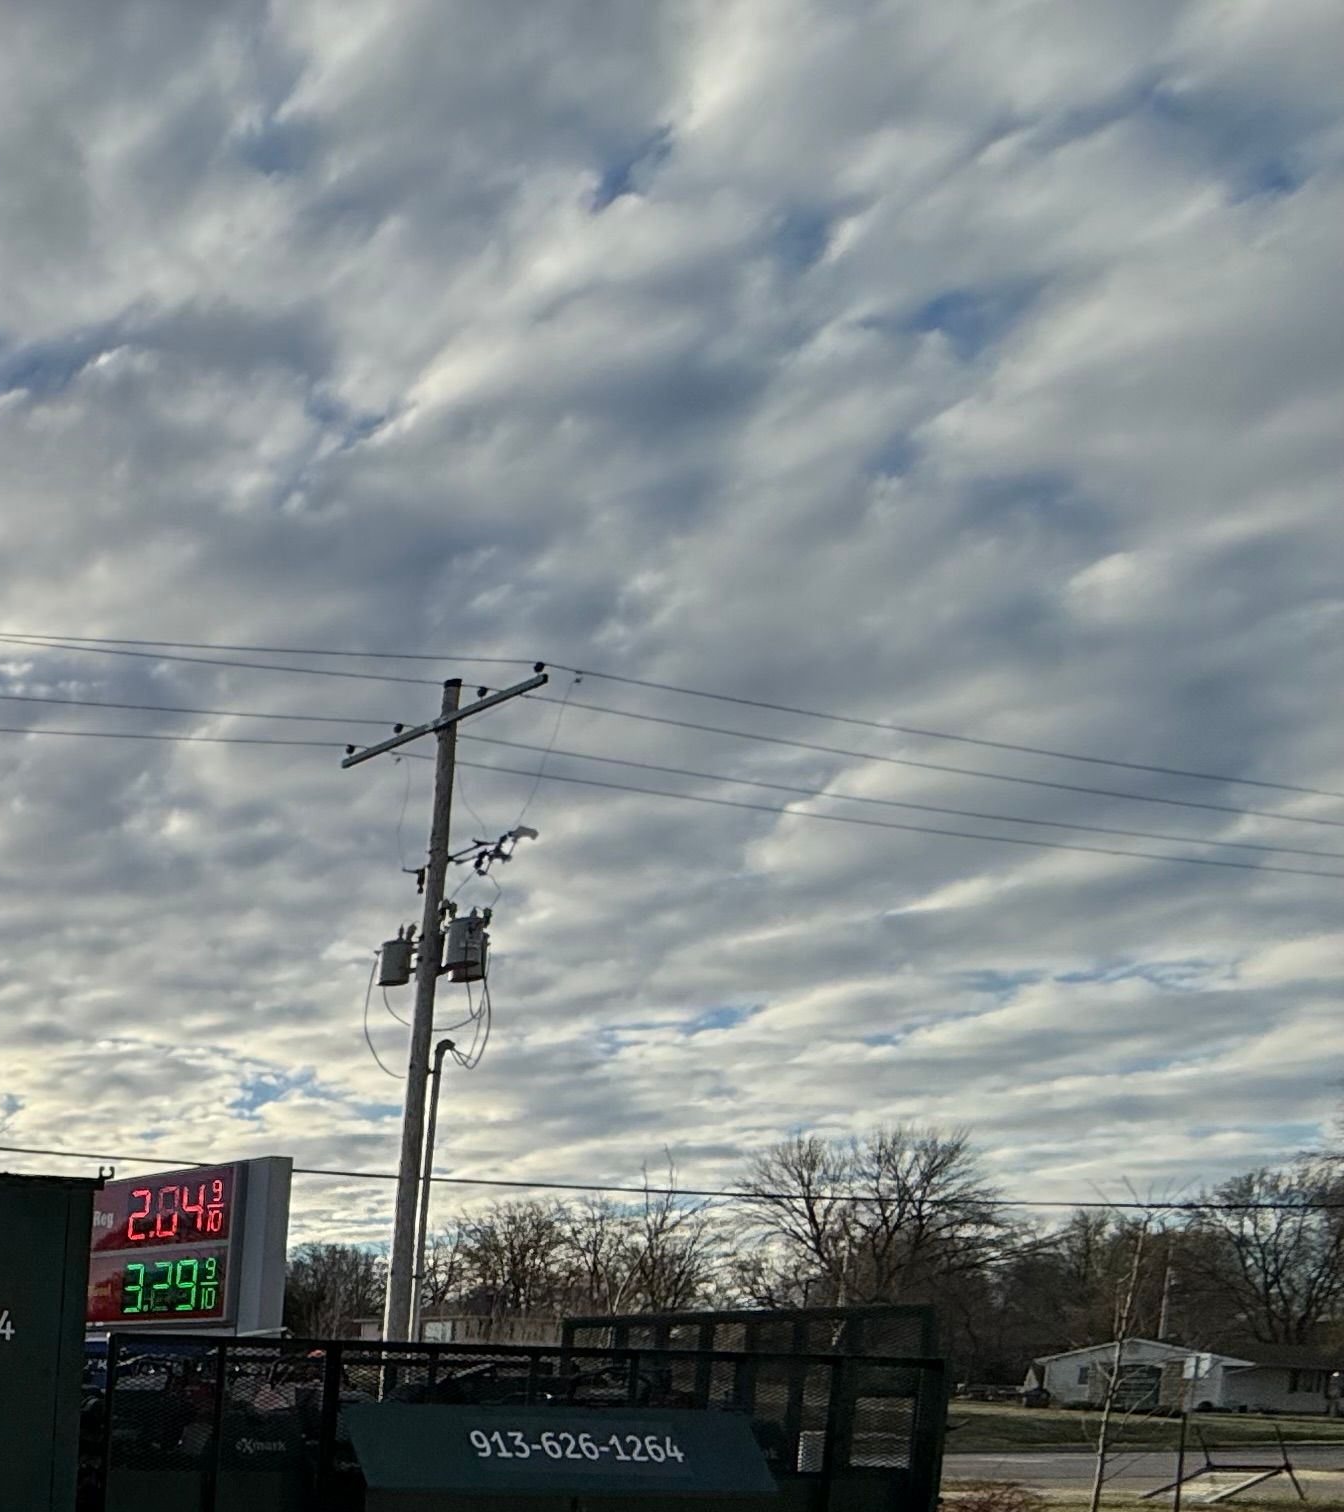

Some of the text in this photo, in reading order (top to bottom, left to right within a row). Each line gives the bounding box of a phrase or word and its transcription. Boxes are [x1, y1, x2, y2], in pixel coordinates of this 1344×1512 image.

[93, 1211, 114, 1229] Reg
[127, 1183, 207, 1240] 2.04
[123, 1259, 199, 1314] 3.29
[469, 1430, 685, 1463] 913-626-1264
